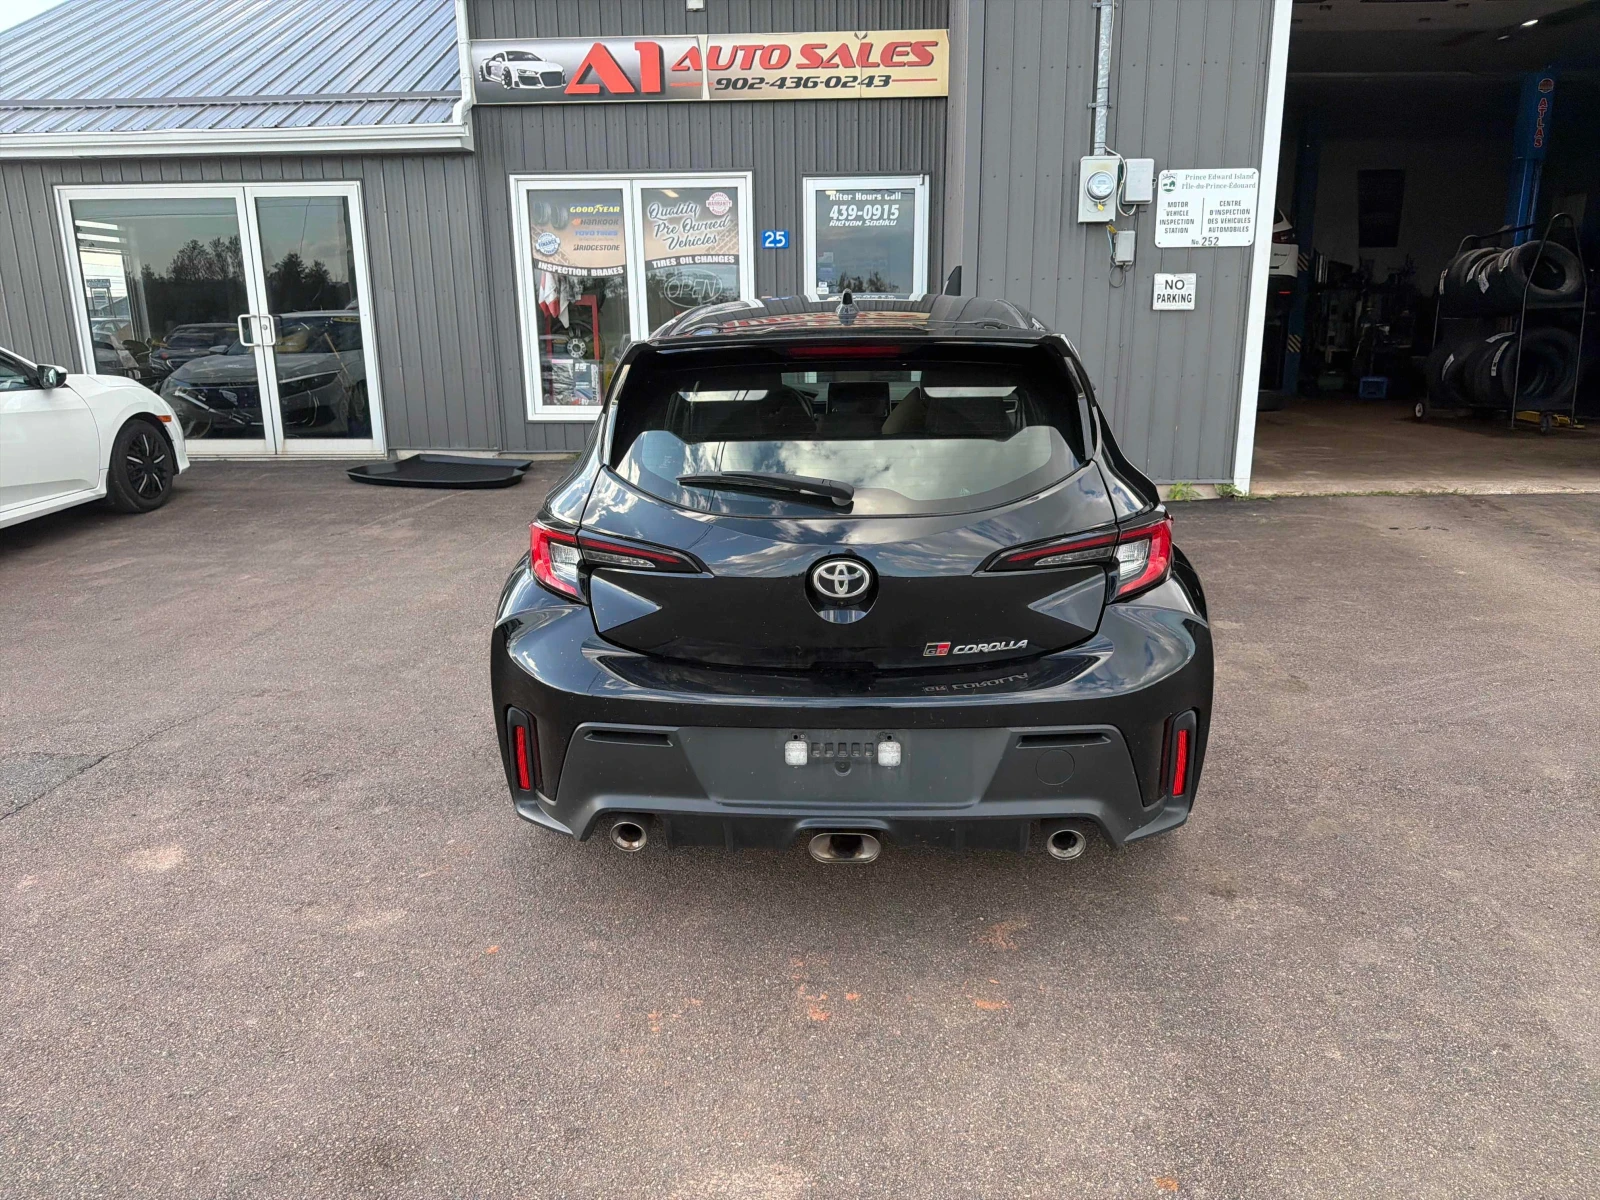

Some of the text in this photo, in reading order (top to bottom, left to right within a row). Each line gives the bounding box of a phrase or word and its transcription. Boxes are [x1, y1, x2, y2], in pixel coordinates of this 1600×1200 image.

[564, 40, 938, 94] A1 AUTO SALES
[714, 73, 892, 91] 902-436-0243
[1534, 97, 1548, 147] ATLAS
[1234, 172, 1254, 180] Island
[829, 191, 901, 200] After Hours Call
[569, 204, 620, 214] GOODYEAR
[648, 201, 699, 221] Quality
[829, 204, 900, 220] 439-0915
[1209, 208, 1251, 216] D'INSPECTION
[654, 213, 730, 238] Pre Owned
[662, 232, 717, 250] Vehicles
[764, 231, 786, 247] 25
[1201, 236, 1220, 246] 252
[573, 243, 621, 251] BRIDGESTONE
[538, 261, 624, 276] INSPECTION BRAKES
[652, 255, 735, 268] TIRES OIL CHANGES
[667, 278, 716, 298] OPEN
[1164, 279, 1185, 290] NO
[1156, 293, 1192, 303] PARKING
[925, 639, 1029, 656] GR COROLLA
